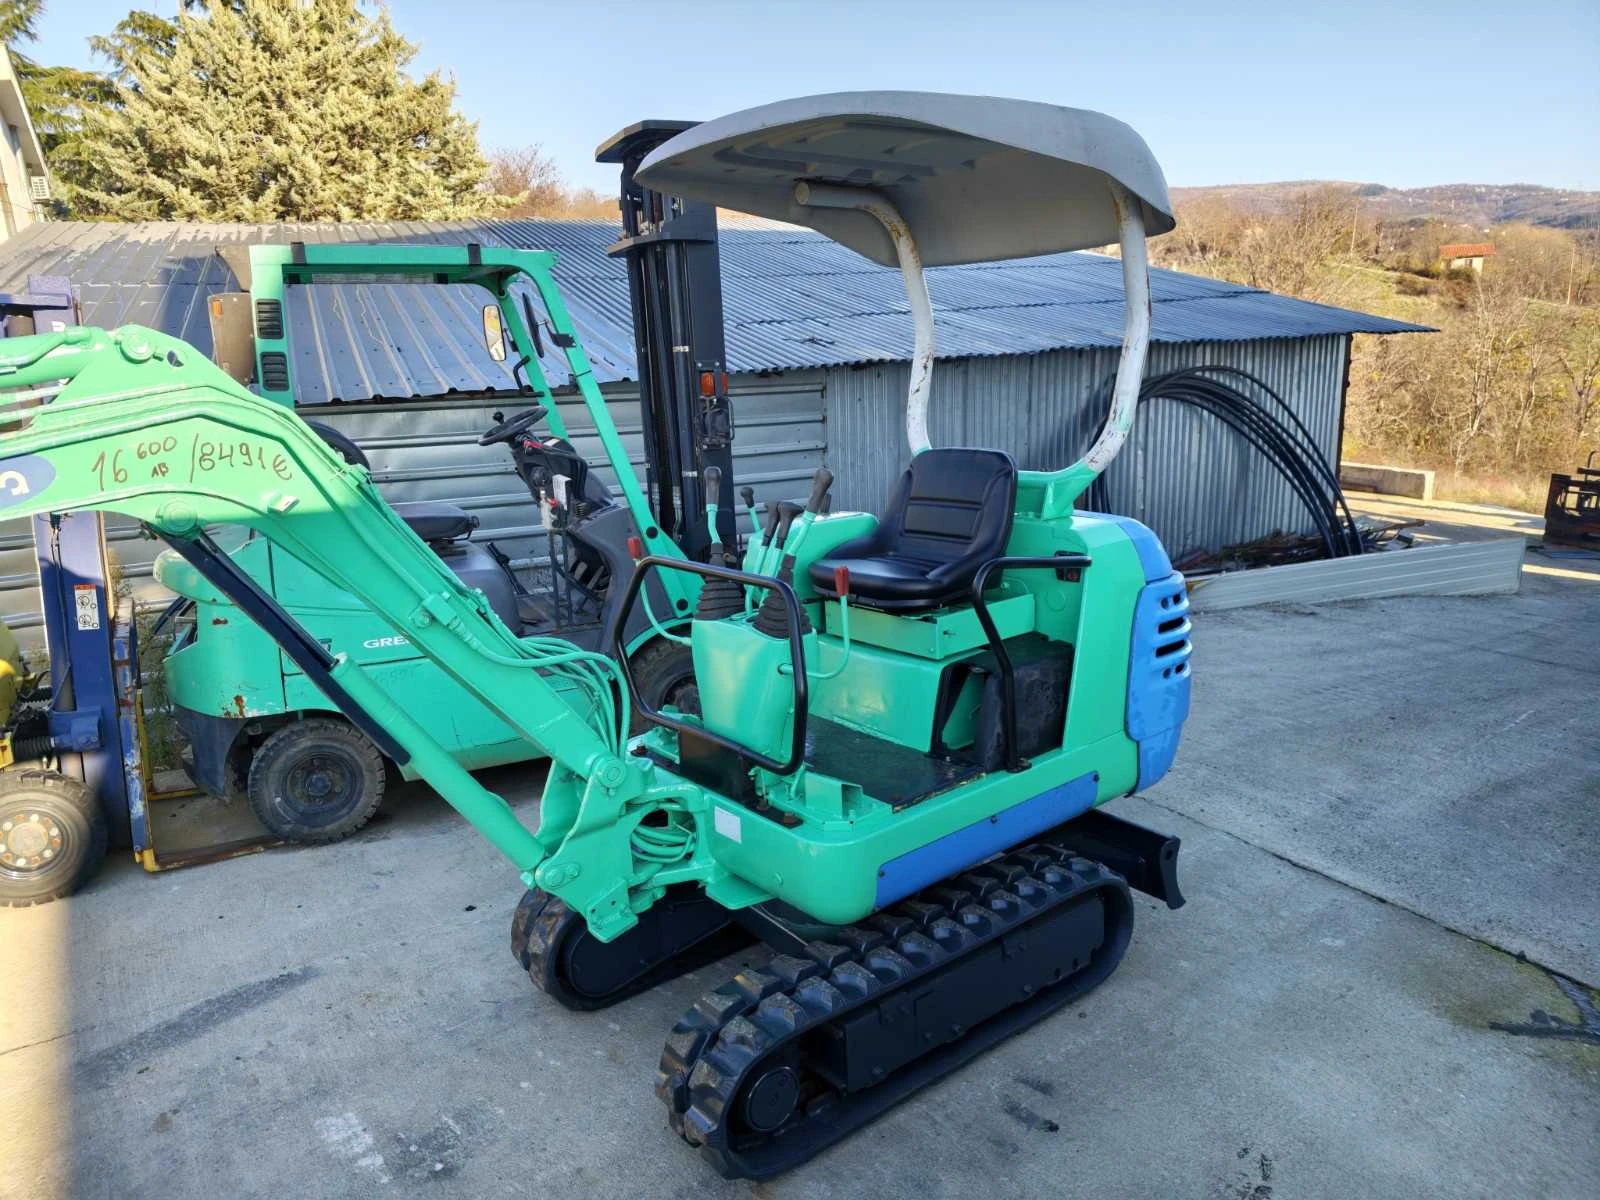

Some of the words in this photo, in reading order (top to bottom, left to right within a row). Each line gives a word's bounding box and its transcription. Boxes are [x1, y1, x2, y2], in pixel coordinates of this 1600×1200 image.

[92, 451, 128, 491] 16
[137, 436, 177, 459] 600
[363, 635, 410, 649] GRE
